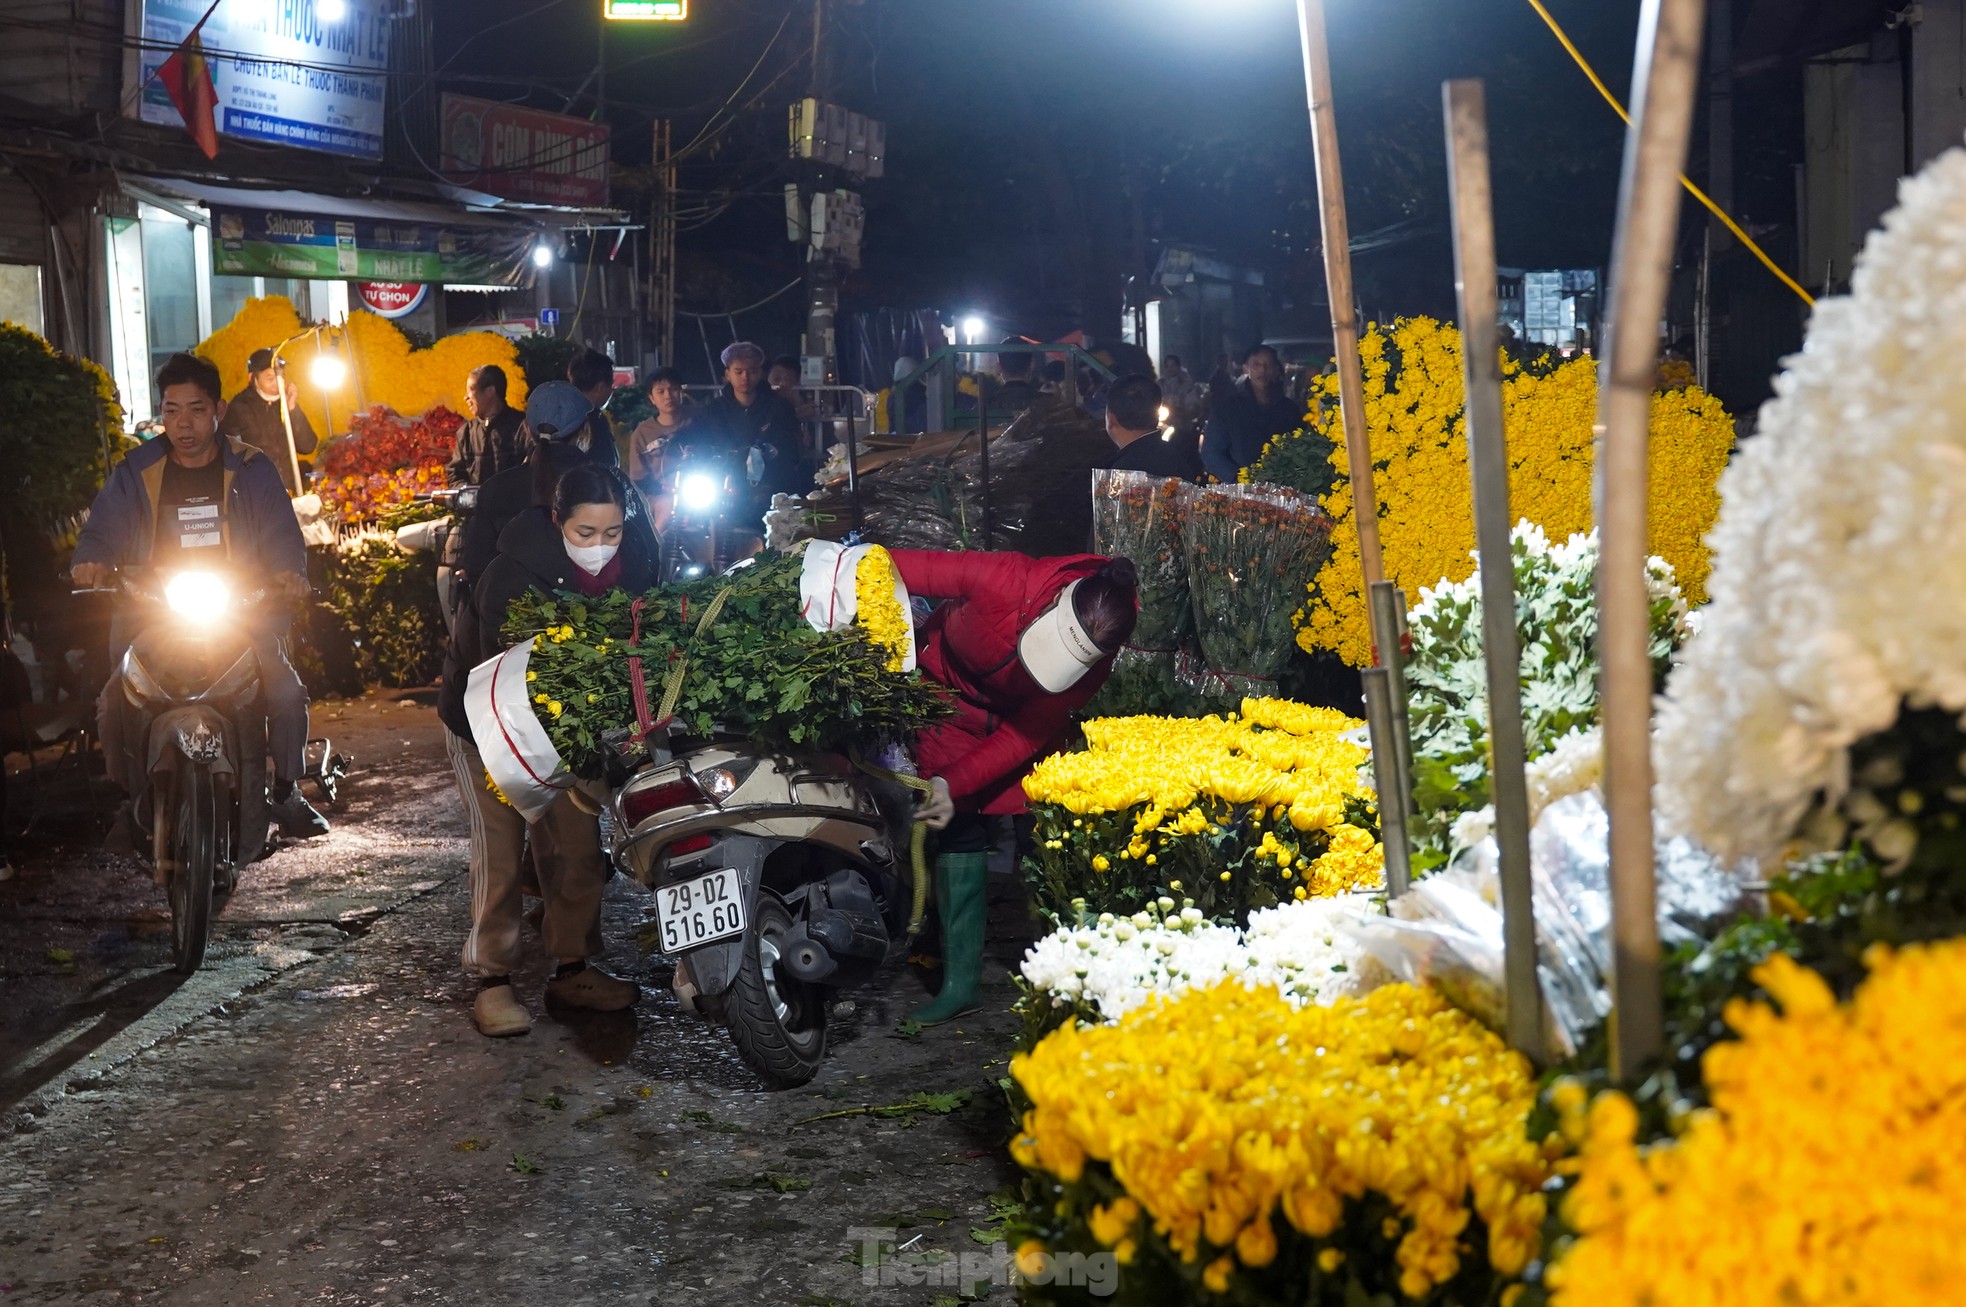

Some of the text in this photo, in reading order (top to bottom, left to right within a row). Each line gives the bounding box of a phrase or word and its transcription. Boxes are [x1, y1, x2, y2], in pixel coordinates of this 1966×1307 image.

[265, 212, 315, 241] Salonpas
[379, 291, 410, 303] CHỌN
[667, 874, 728, 916] 29-D2
[665, 902, 740, 947] 516.60
